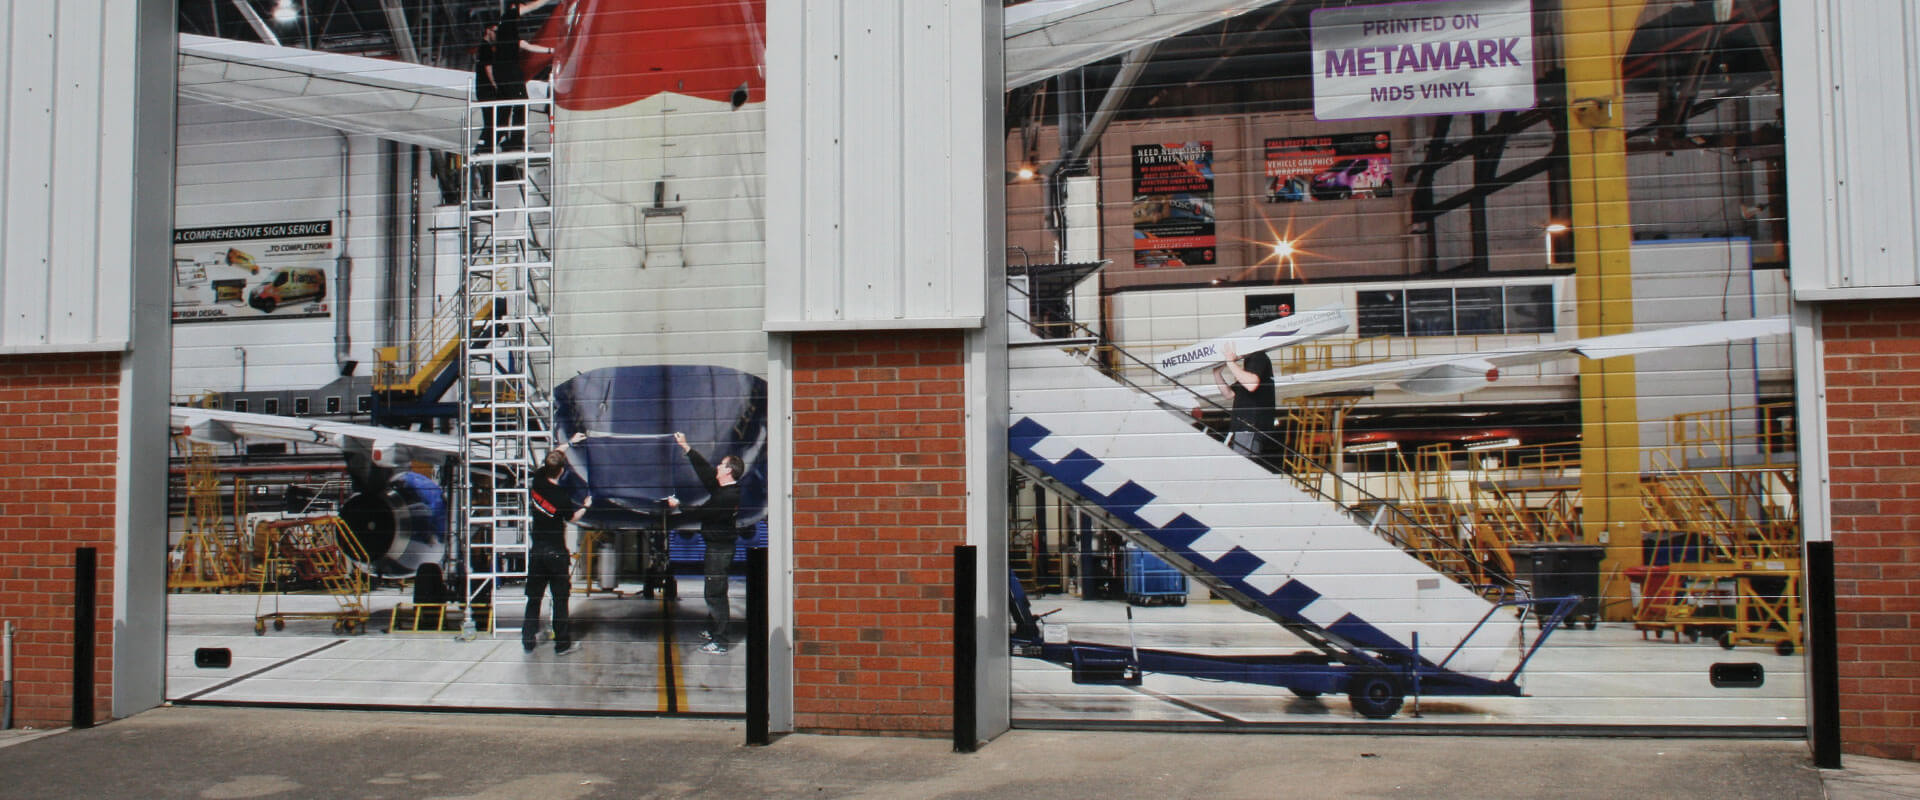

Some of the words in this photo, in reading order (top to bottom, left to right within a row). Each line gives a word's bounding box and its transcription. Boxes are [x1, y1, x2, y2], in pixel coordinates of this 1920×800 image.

[1363, 15, 1446, 36] PRINTED
[1452, 13, 1479, 30] ON
[1325, 38, 1522, 78] METAMARK
[1370, 85, 1415, 102] MD5
[1420, 81, 1475, 99] VINYL
[1137, 148, 1159, 157] NEED
[1139, 156, 1155, 164] FOR
[1158, 155, 1176, 163] THIS
[1267, 159, 1297, 168] VEHICLE
[1298, 157, 1334, 166] GRAPHICS
[1274, 167, 1314, 176] WRAPPING
[175, 232, 182, 241] A
[183, 227, 261, 241] COMPREHENSIVE
[262, 225, 287, 237] SIGN
[287, 223, 327, 235] SERVICE
[1162, 344, 1217, 369] METAMARK
